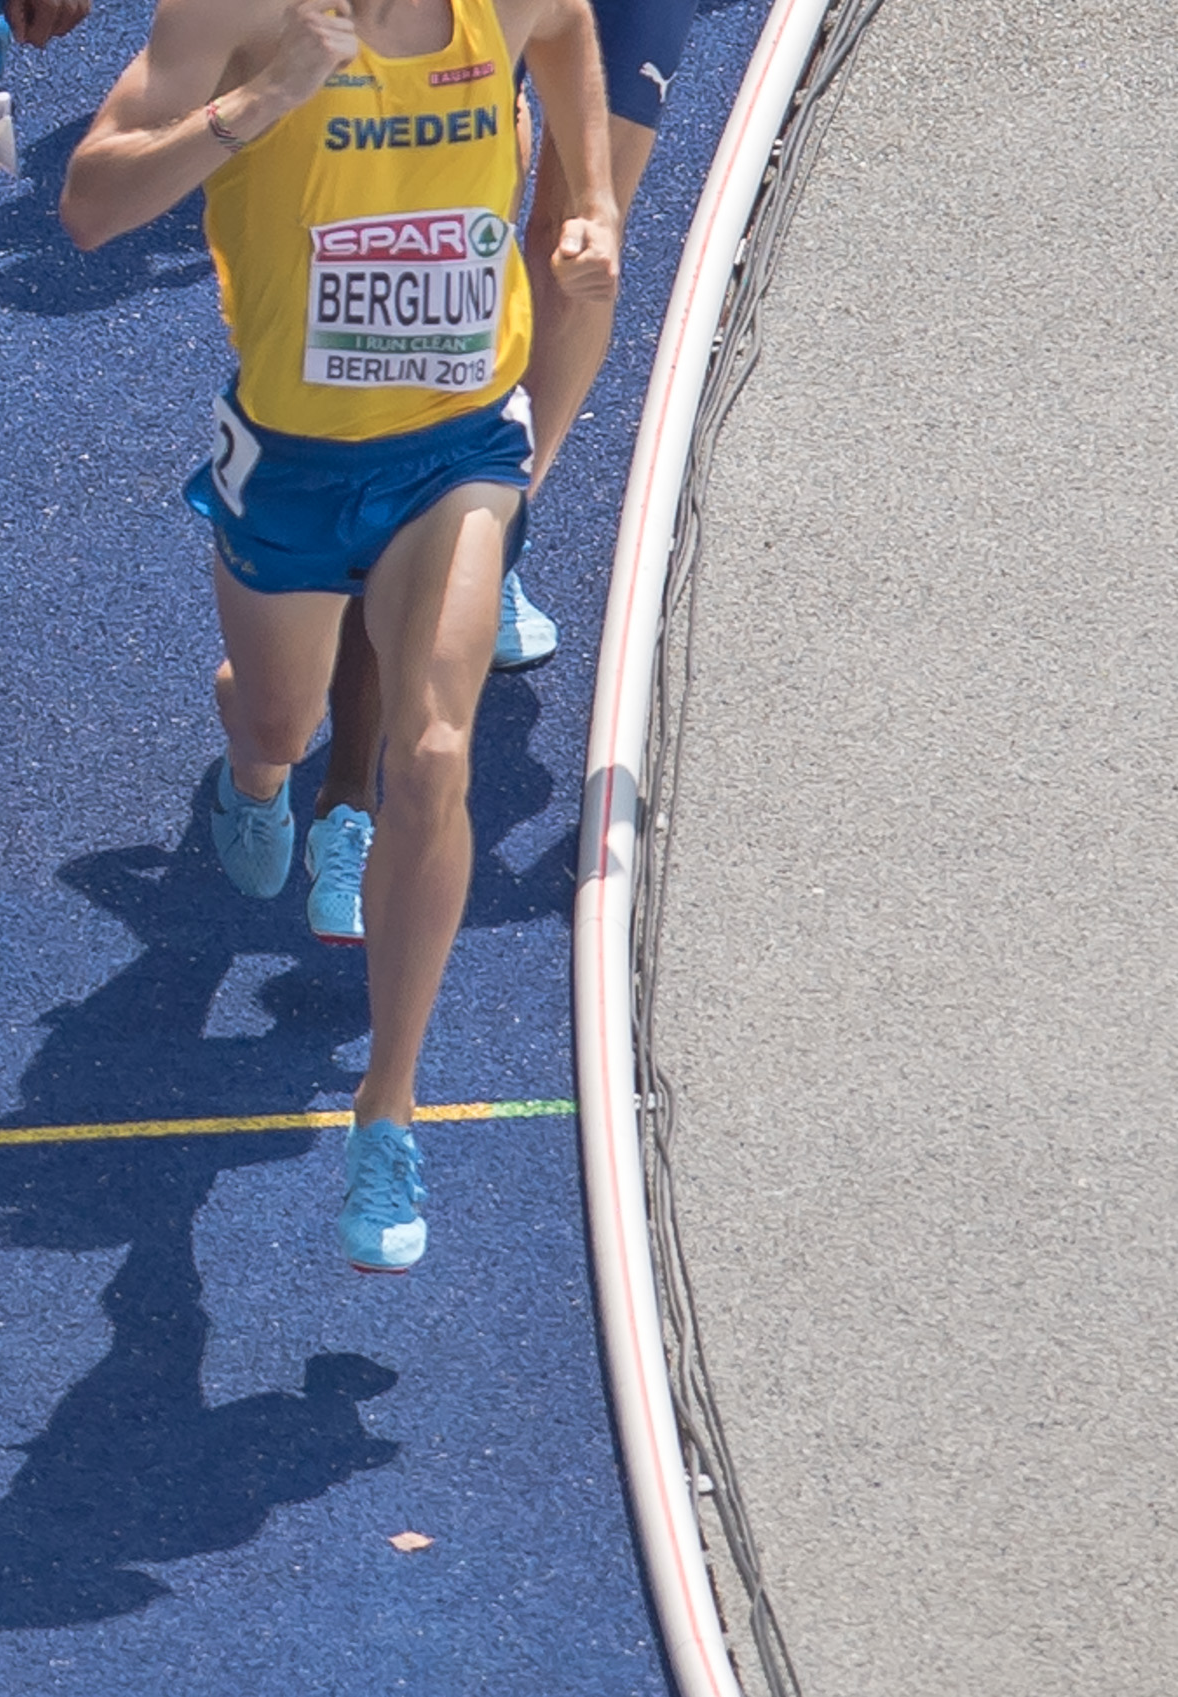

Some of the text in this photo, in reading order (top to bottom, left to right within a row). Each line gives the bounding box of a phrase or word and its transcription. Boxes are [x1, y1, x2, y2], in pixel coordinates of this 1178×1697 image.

[325, 105, 499, 151] SWEDEN
[323, 220, 464, 255] SPAR
[317, 266, 497, 327] BERGLUND
[366, 337, 405, 351] RUN
[326, 355, 486, 385] BERLIN 2018
